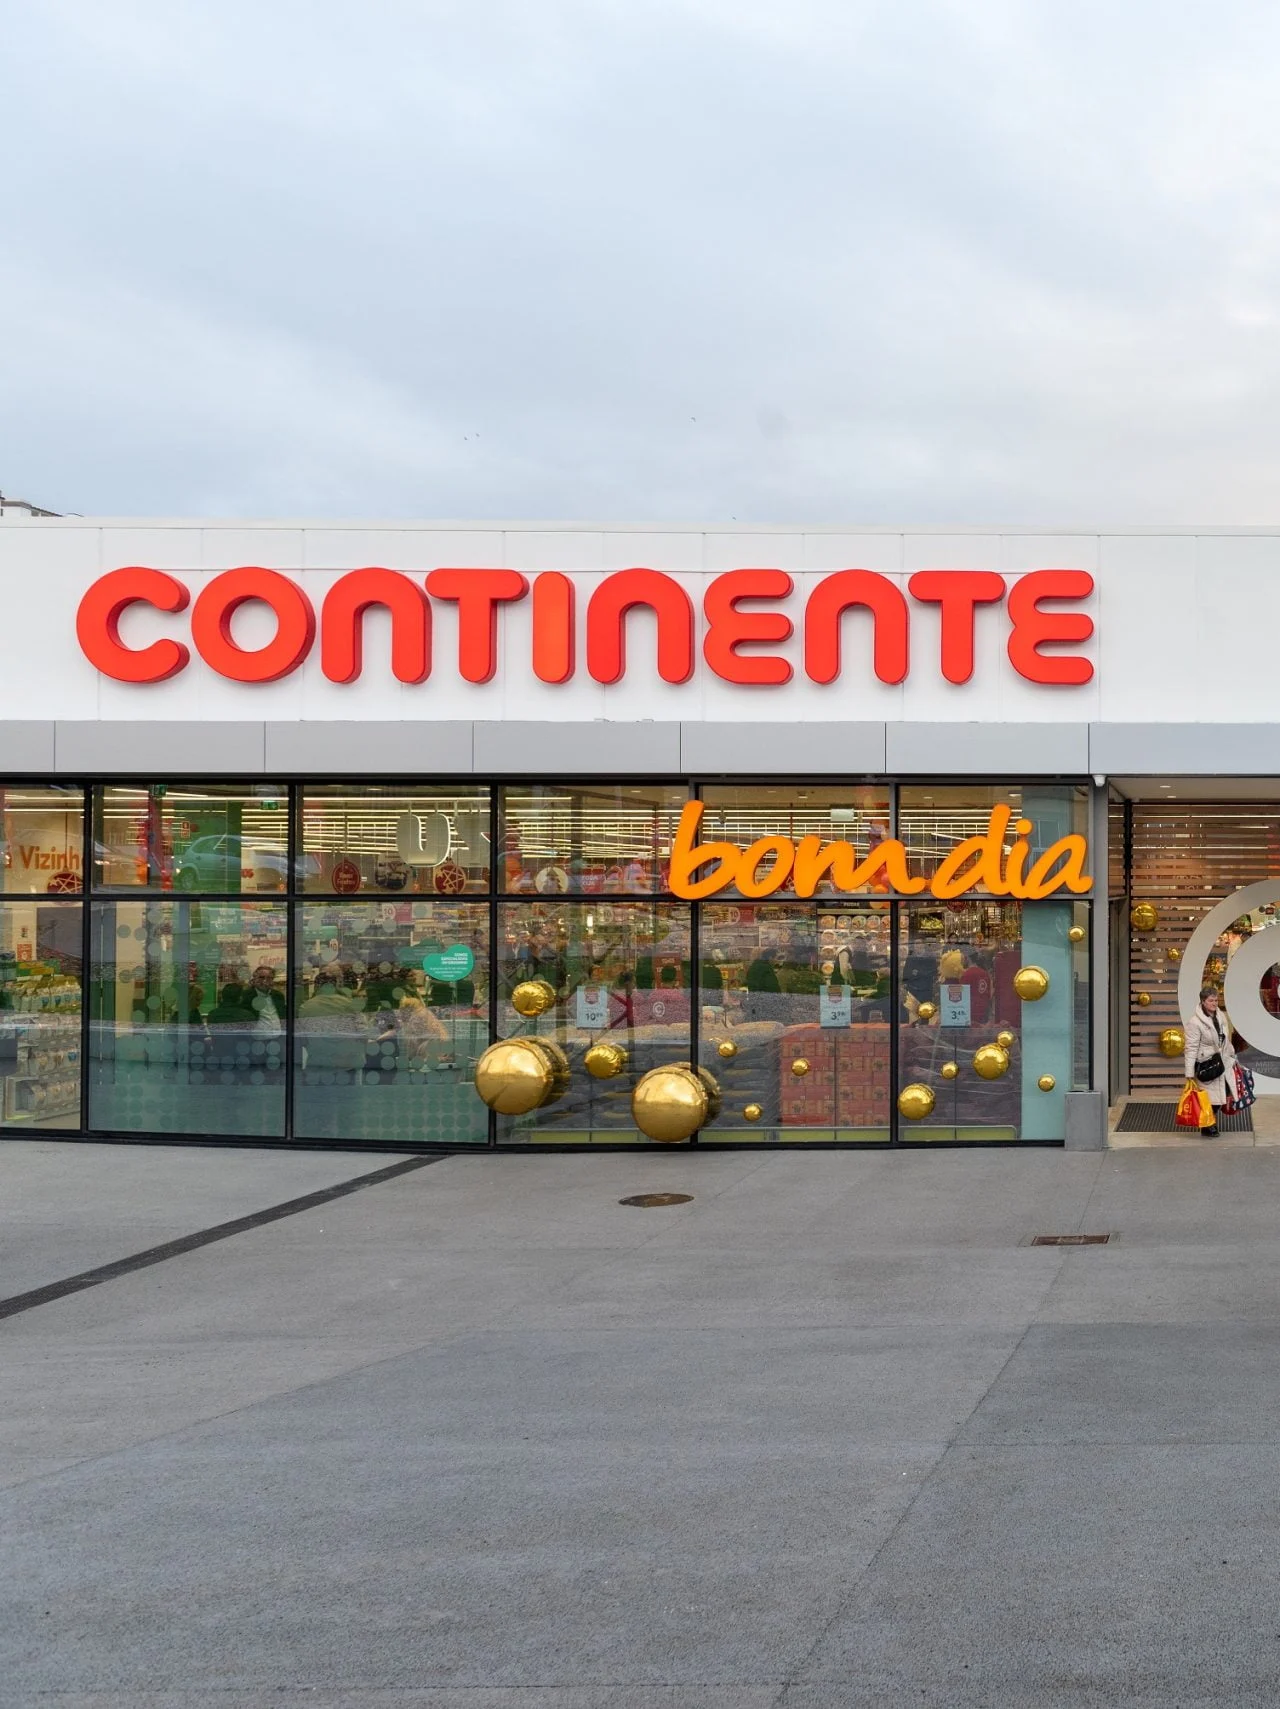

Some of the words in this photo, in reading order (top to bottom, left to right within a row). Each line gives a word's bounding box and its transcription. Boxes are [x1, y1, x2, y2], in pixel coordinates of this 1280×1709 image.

[77, 567, 1094, 687] CONTINENTE
[20, 844, 84, 870] Vizinh
[668, 800, 928, 899] bom
[930, 804, 1093, 899] dia
